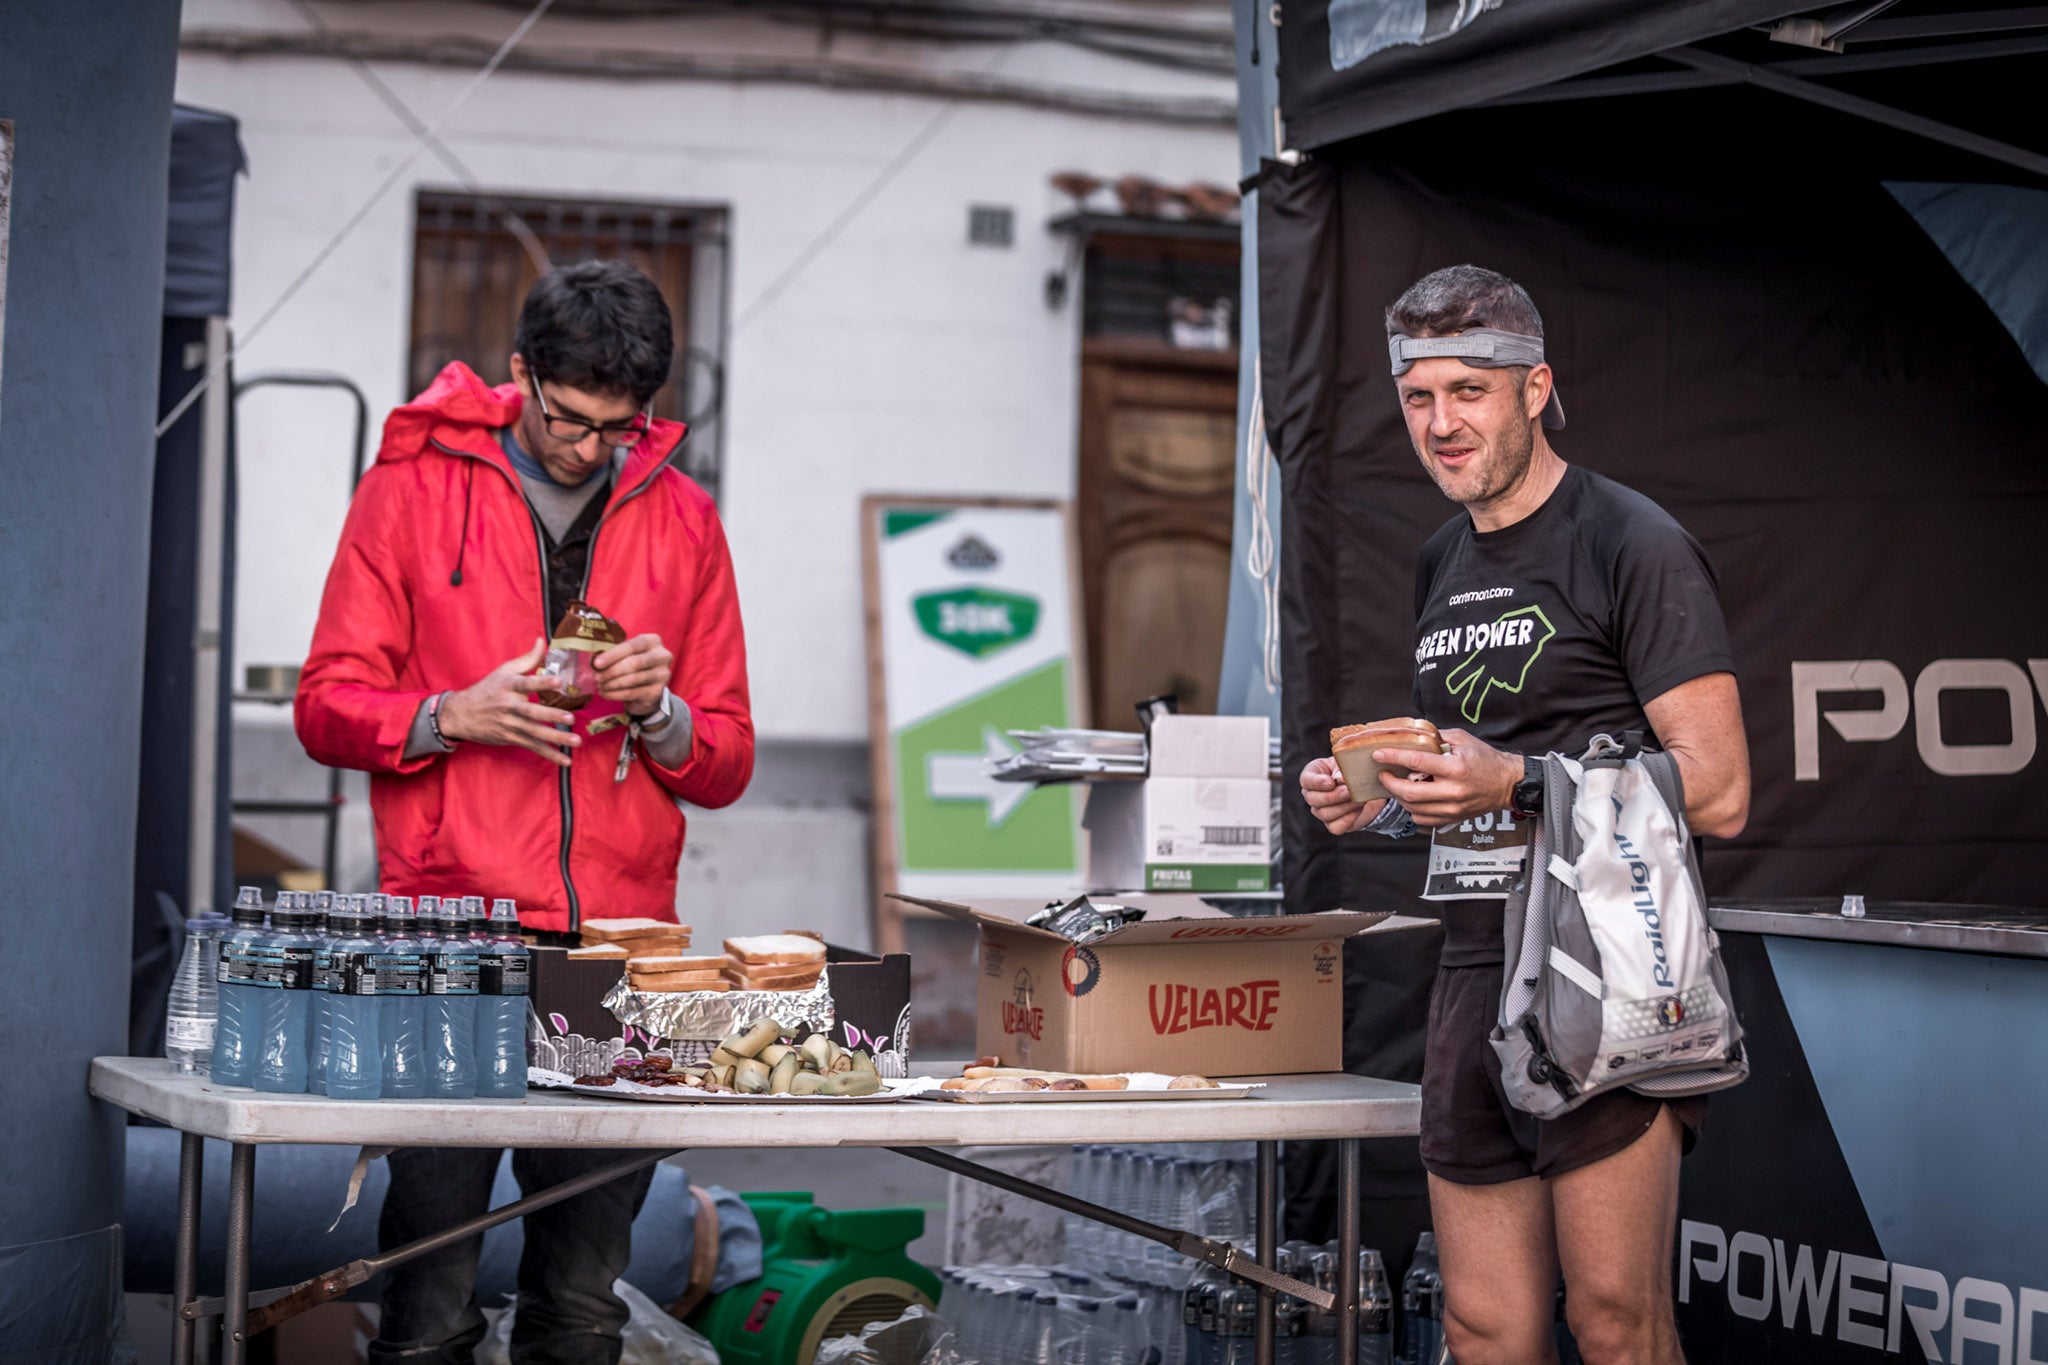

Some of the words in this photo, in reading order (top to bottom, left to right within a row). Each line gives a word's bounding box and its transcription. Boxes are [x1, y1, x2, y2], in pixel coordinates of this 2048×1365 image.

[1465, 618, 1534, 653] POWER
[1791, 658, 2048, 781] PO
[1152, 869, 1192, 880] FRUTAS
[1002, 1000, 1044, 1041] VELARTE
[1148, 980, 1280, 1035] VELARTE
